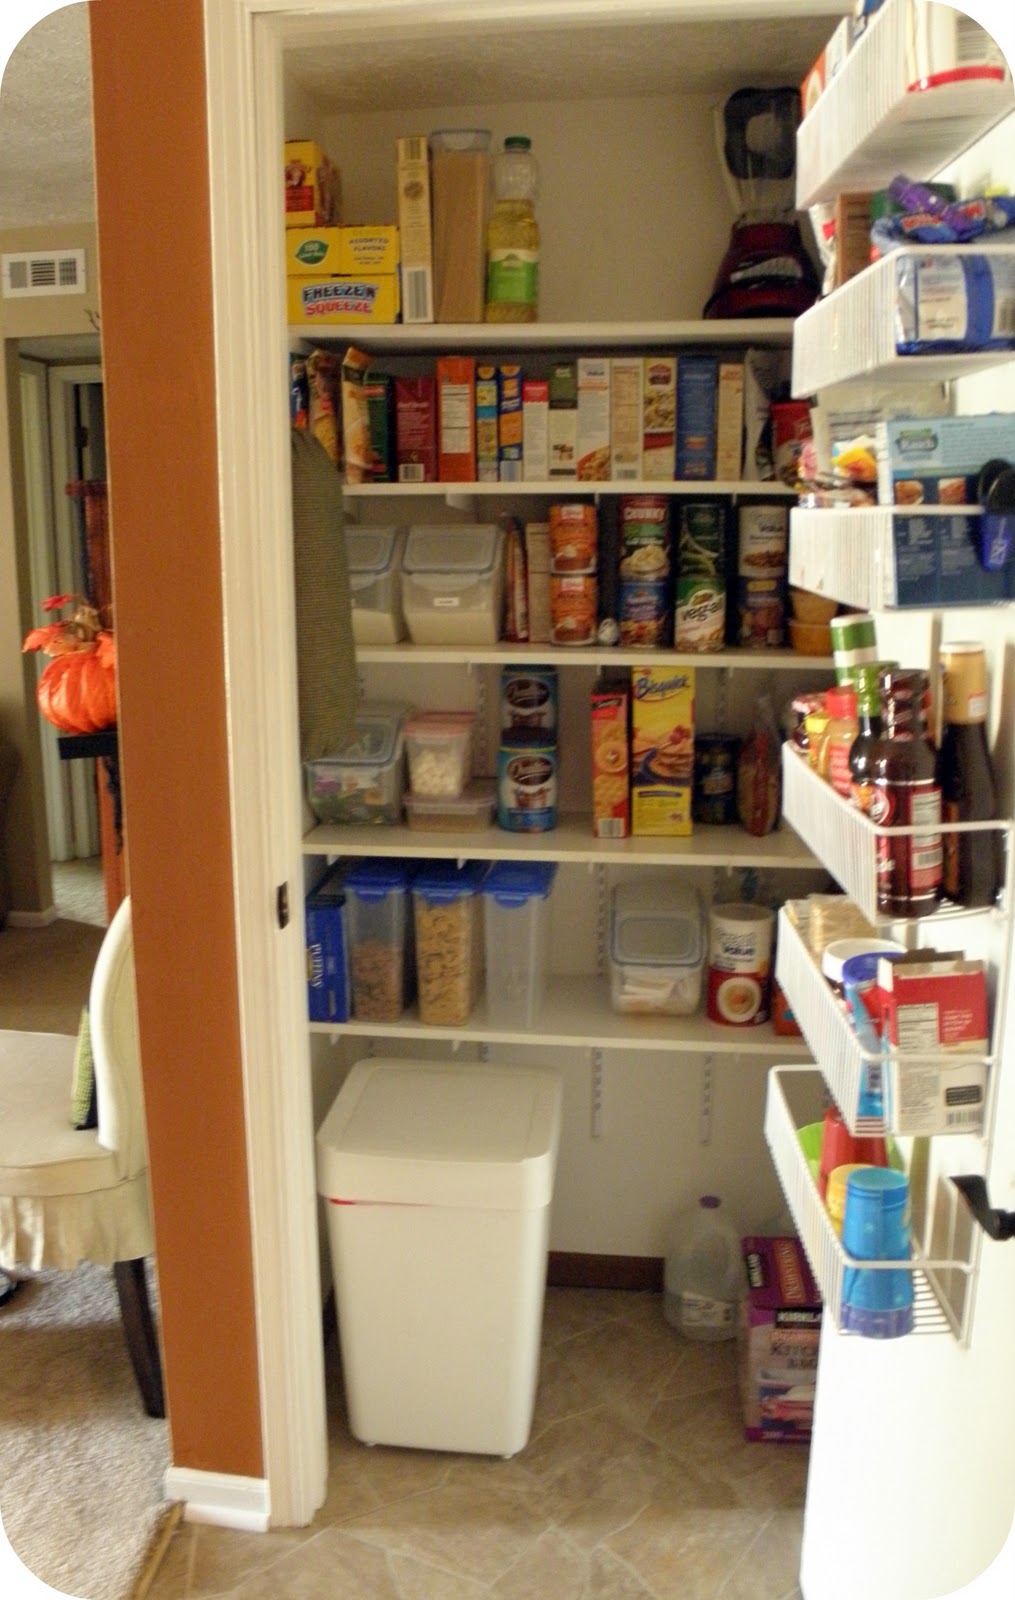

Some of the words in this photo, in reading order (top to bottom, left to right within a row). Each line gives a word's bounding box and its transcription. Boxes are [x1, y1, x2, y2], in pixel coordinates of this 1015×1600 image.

[305, 299, 373, 316] SQUEEZE
[623, 507, 666, 521] CHUNKY
[635, 674, 690, 701] Bisquick
[723, 943, 754, 956] Value
